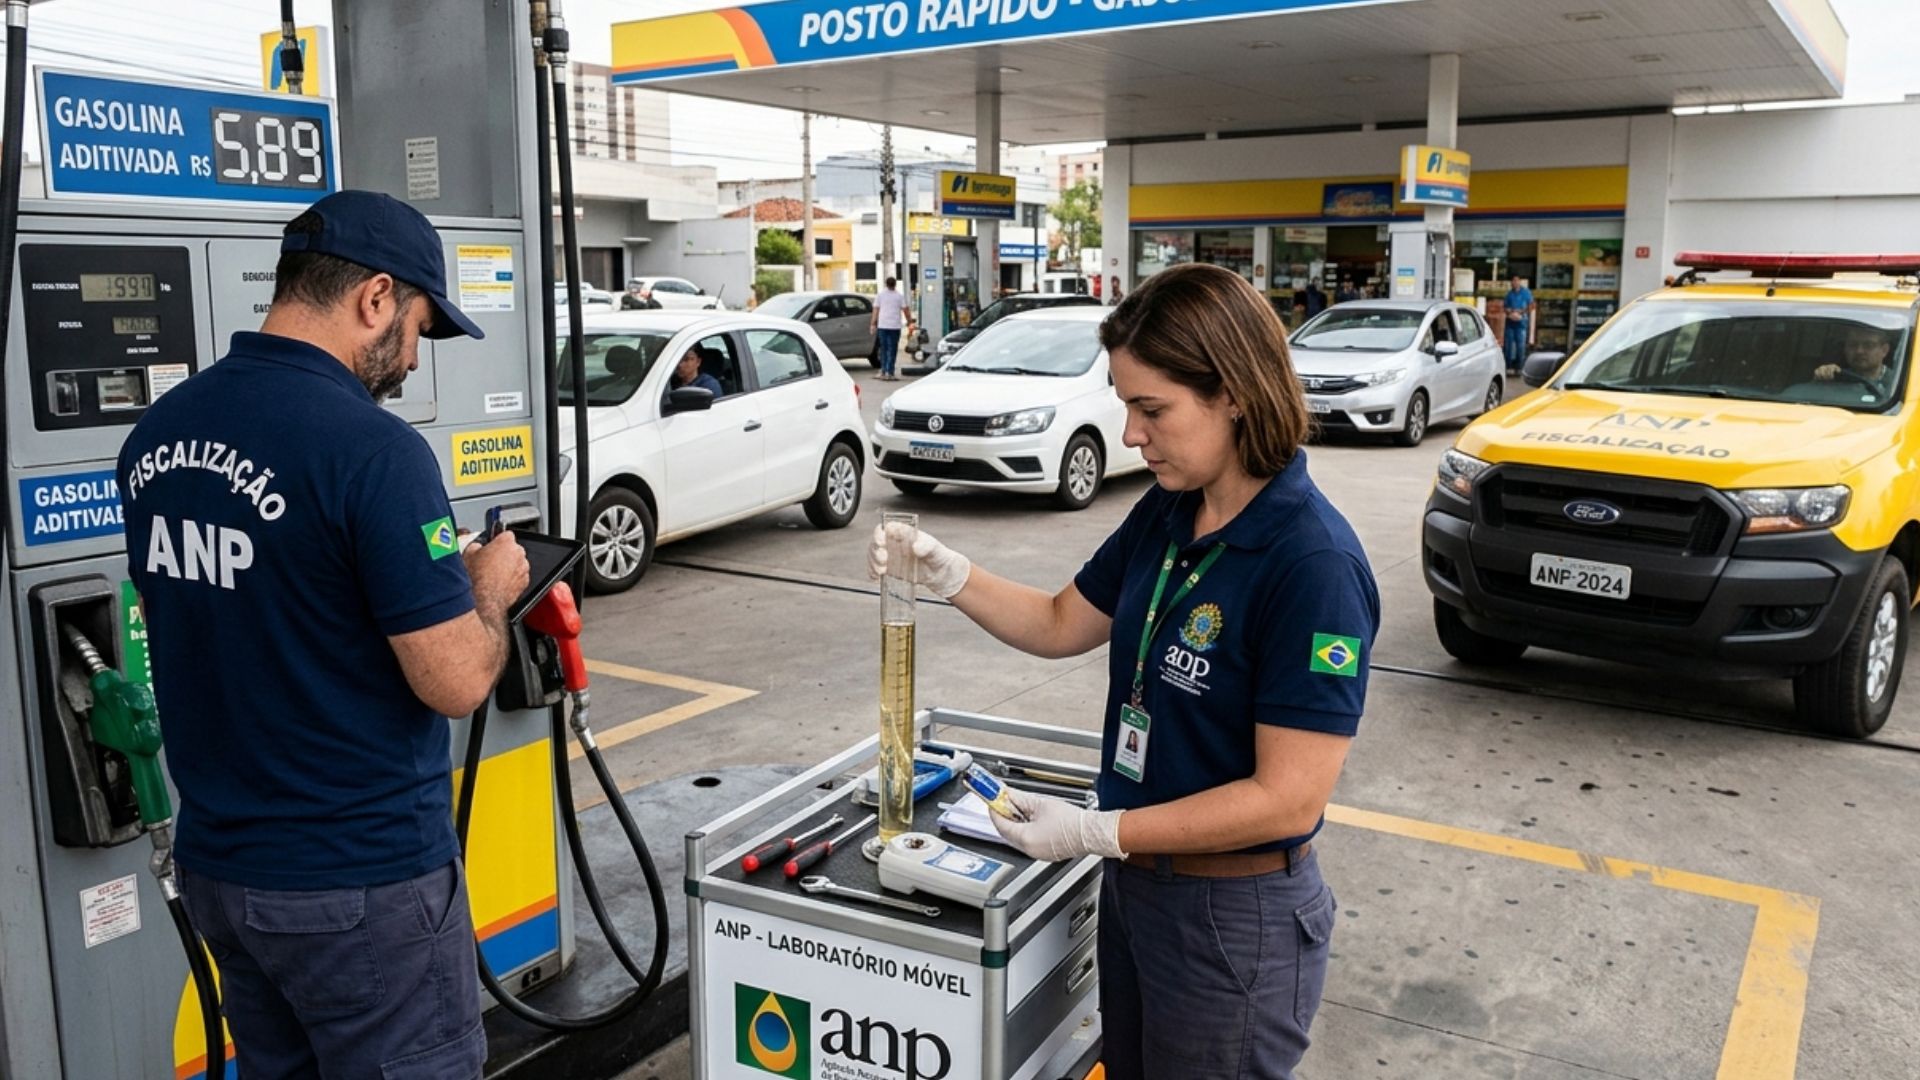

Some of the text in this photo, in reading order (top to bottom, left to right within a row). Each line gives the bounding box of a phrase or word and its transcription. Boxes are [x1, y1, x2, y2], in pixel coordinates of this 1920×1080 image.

[799, 1, 908, 48] POSTO
[54, 95, 185, 137] GASOLINA
[59, 111, 323, 185] ADITIVADA R$ 5,89
[461, 434, 524, 456] GASOLINA
[34, 478, 120, 507] GASOLIN
[128, 439, 287, 522] FISCALIZAÇÃO
[34, 504, 125, 535] ADITIVA
[146, 514, 254, 590] ANP
[1535, 564, 1625, 596] ANP-2024
[714, 918, 752, 941] ANP
[767, 930, 898, 978] LABORATÓRIO
[903, 962, 972, 998] MÓVEL
[819, 1008, 952, 1080] anp
